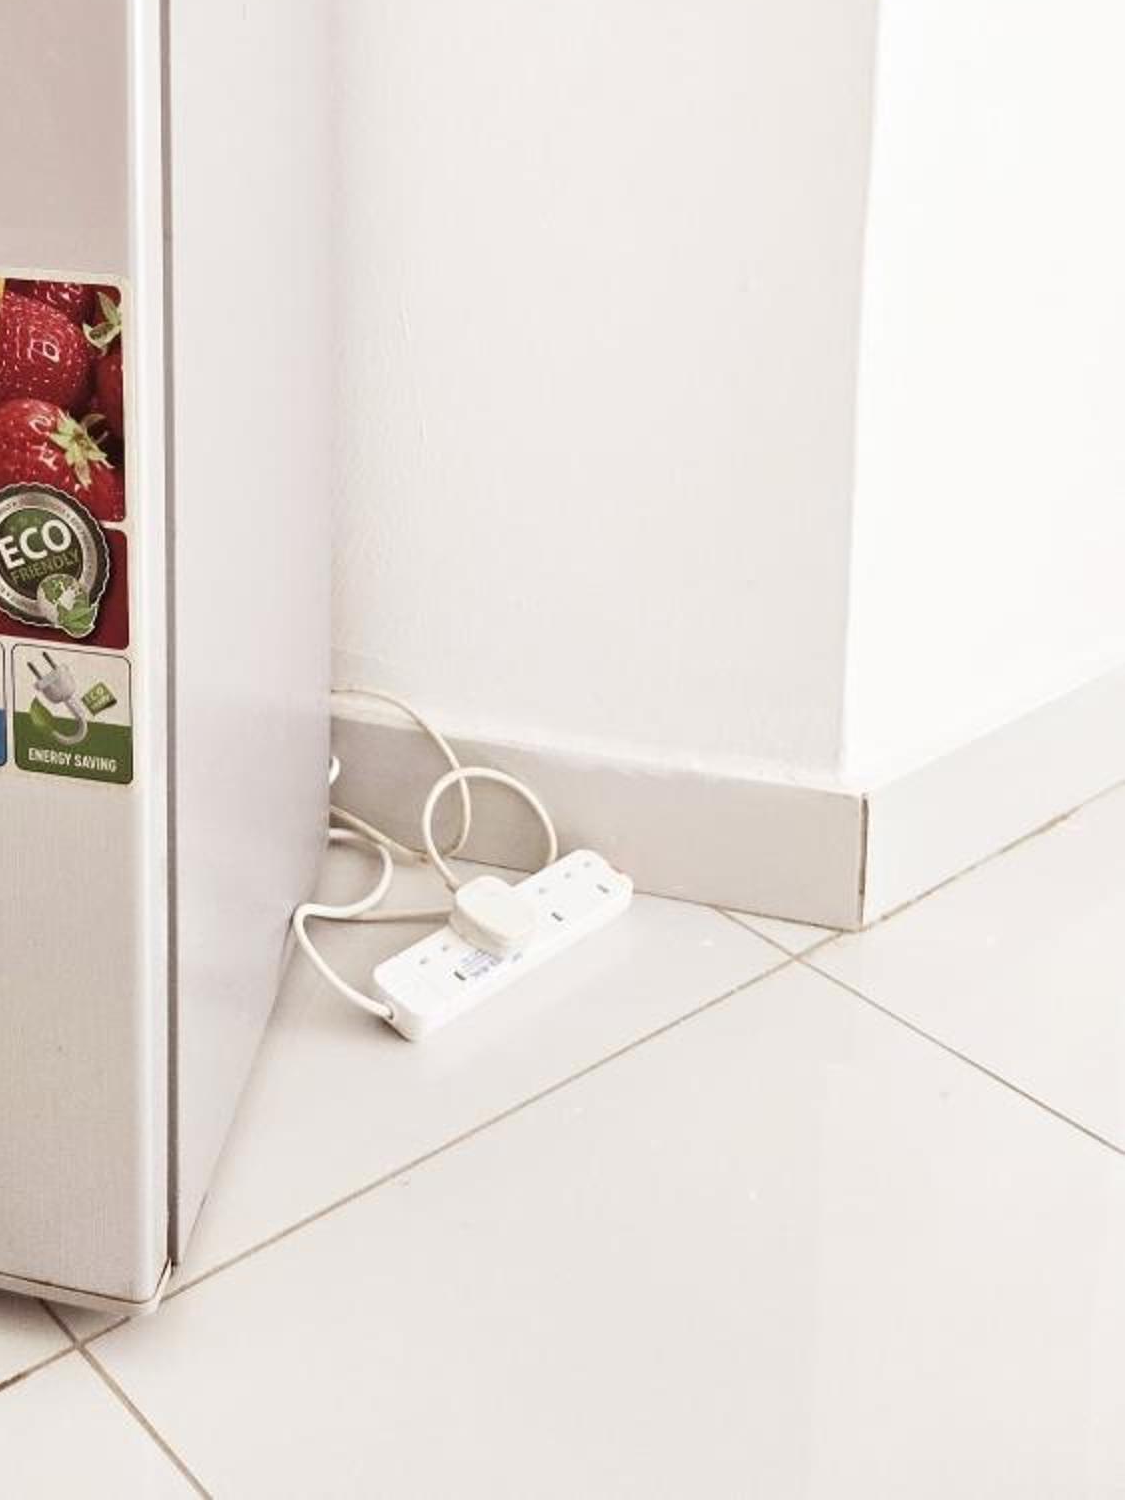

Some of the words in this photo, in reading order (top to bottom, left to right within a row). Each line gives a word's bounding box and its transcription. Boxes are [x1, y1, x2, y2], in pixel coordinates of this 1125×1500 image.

[10, 550, 80, 583] FRIENDLY
[28, 747, 73, 767] ENERGY
[74, 753, 118, 774] SAVING
